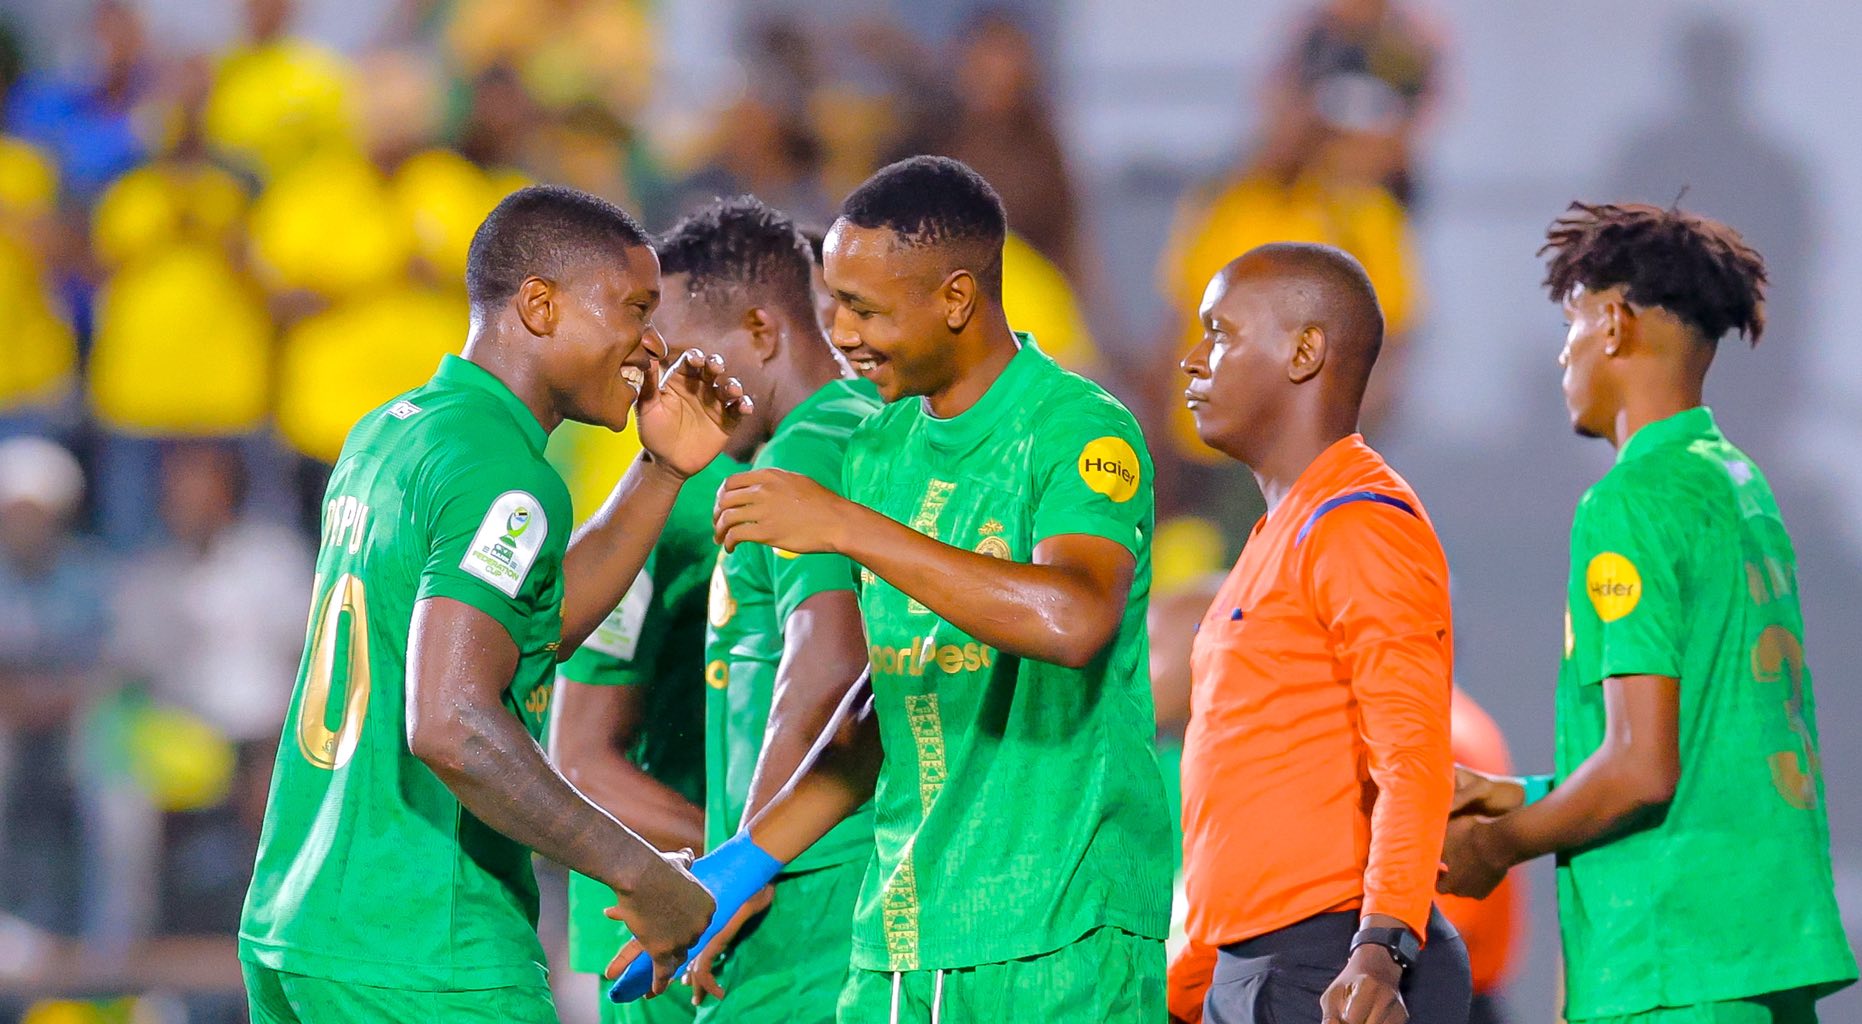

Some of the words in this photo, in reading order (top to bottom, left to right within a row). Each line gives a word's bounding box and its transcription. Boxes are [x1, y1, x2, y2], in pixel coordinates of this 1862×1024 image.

[1085, 458, 1135, 487] Haier
[472, 550, 520, 581] FEDERATION
[485, 565, 502, 577] CUP
[296, 572, 371, 770] 0
